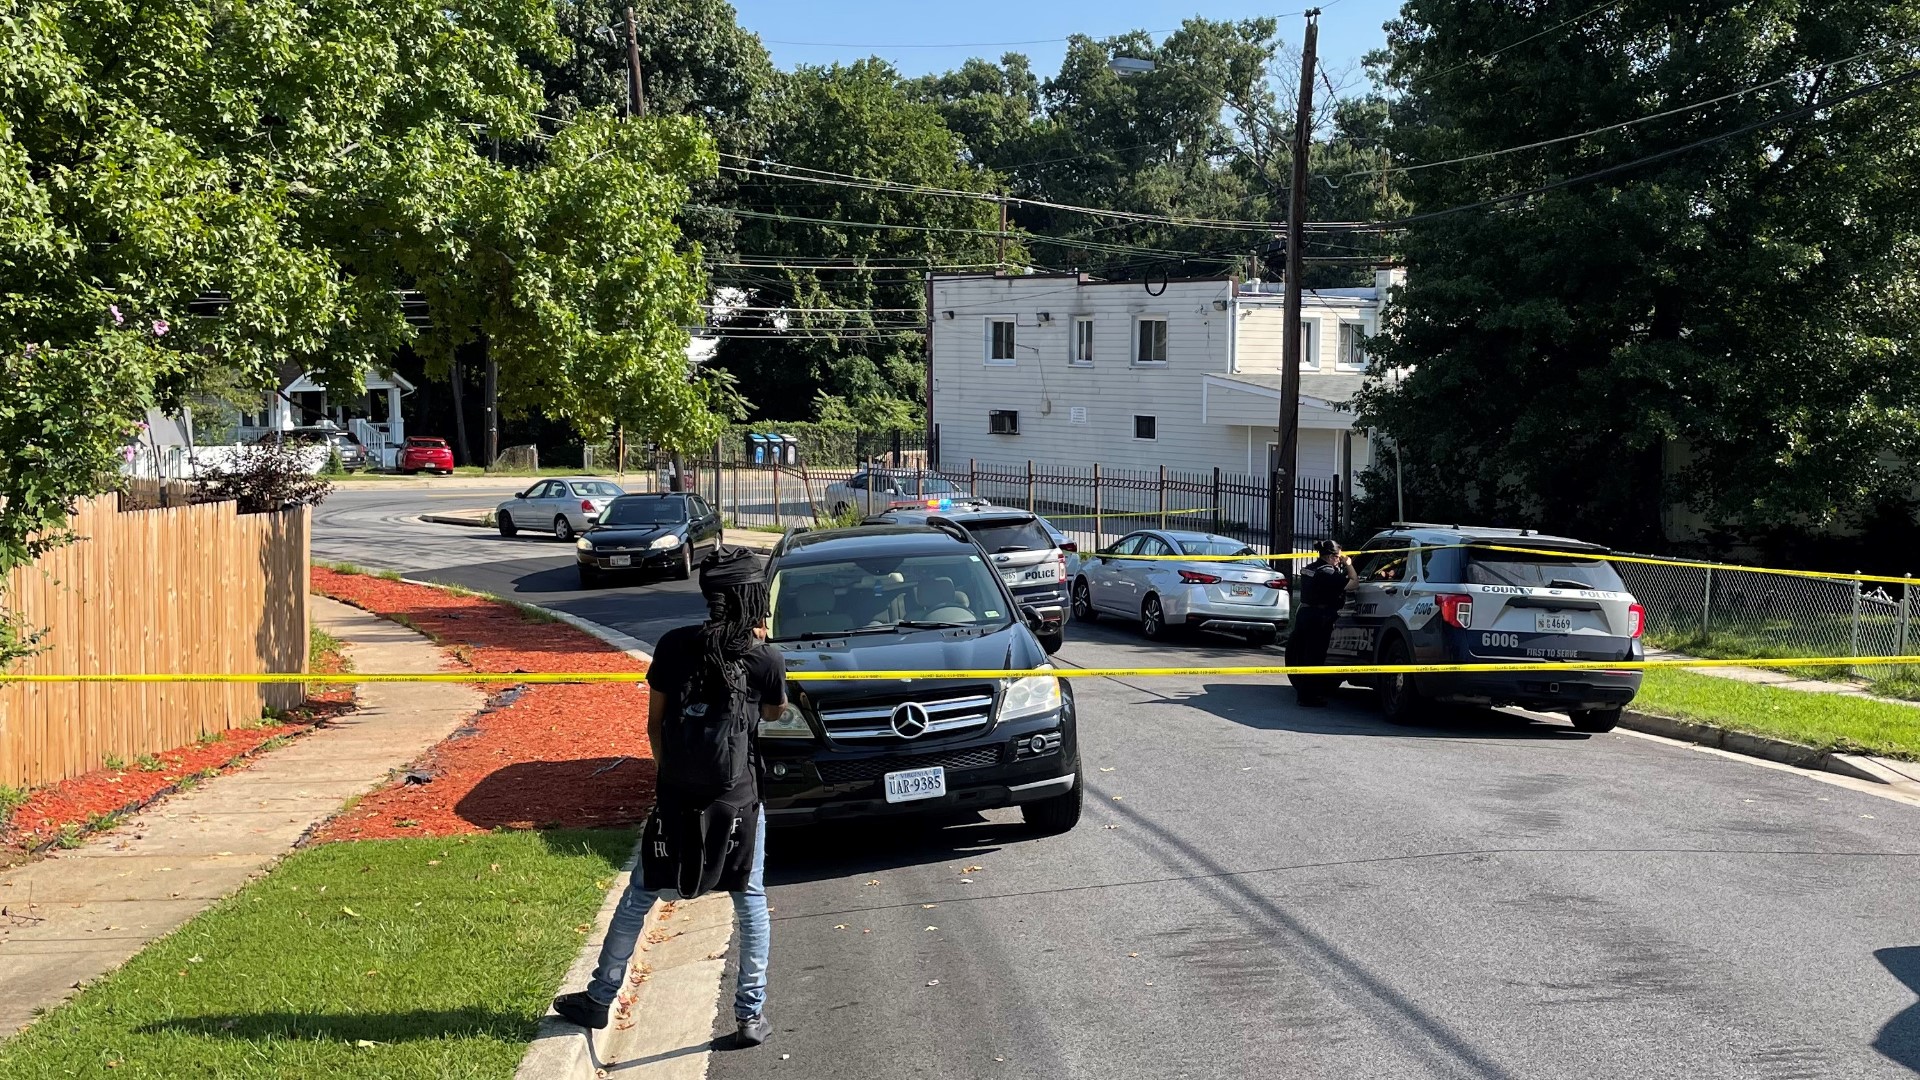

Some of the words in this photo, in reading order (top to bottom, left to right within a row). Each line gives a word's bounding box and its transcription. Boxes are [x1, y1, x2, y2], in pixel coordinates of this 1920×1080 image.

[1025, 569, 1055, 580] POLICE
[1481, 585, 1534, 595] COUNTY
[1414, 602, 1433, 616] 6006
[1552, 618, 1571, 629] 4669
[1481, 632, 1519, 648] 6006
[1526, 648, 1546, 657] FIRST
[1547, 649, 1556, 658] TO
[1556, 649, 1578, 658] SERVE
[889, 775, 942, 795] UAR-9385
